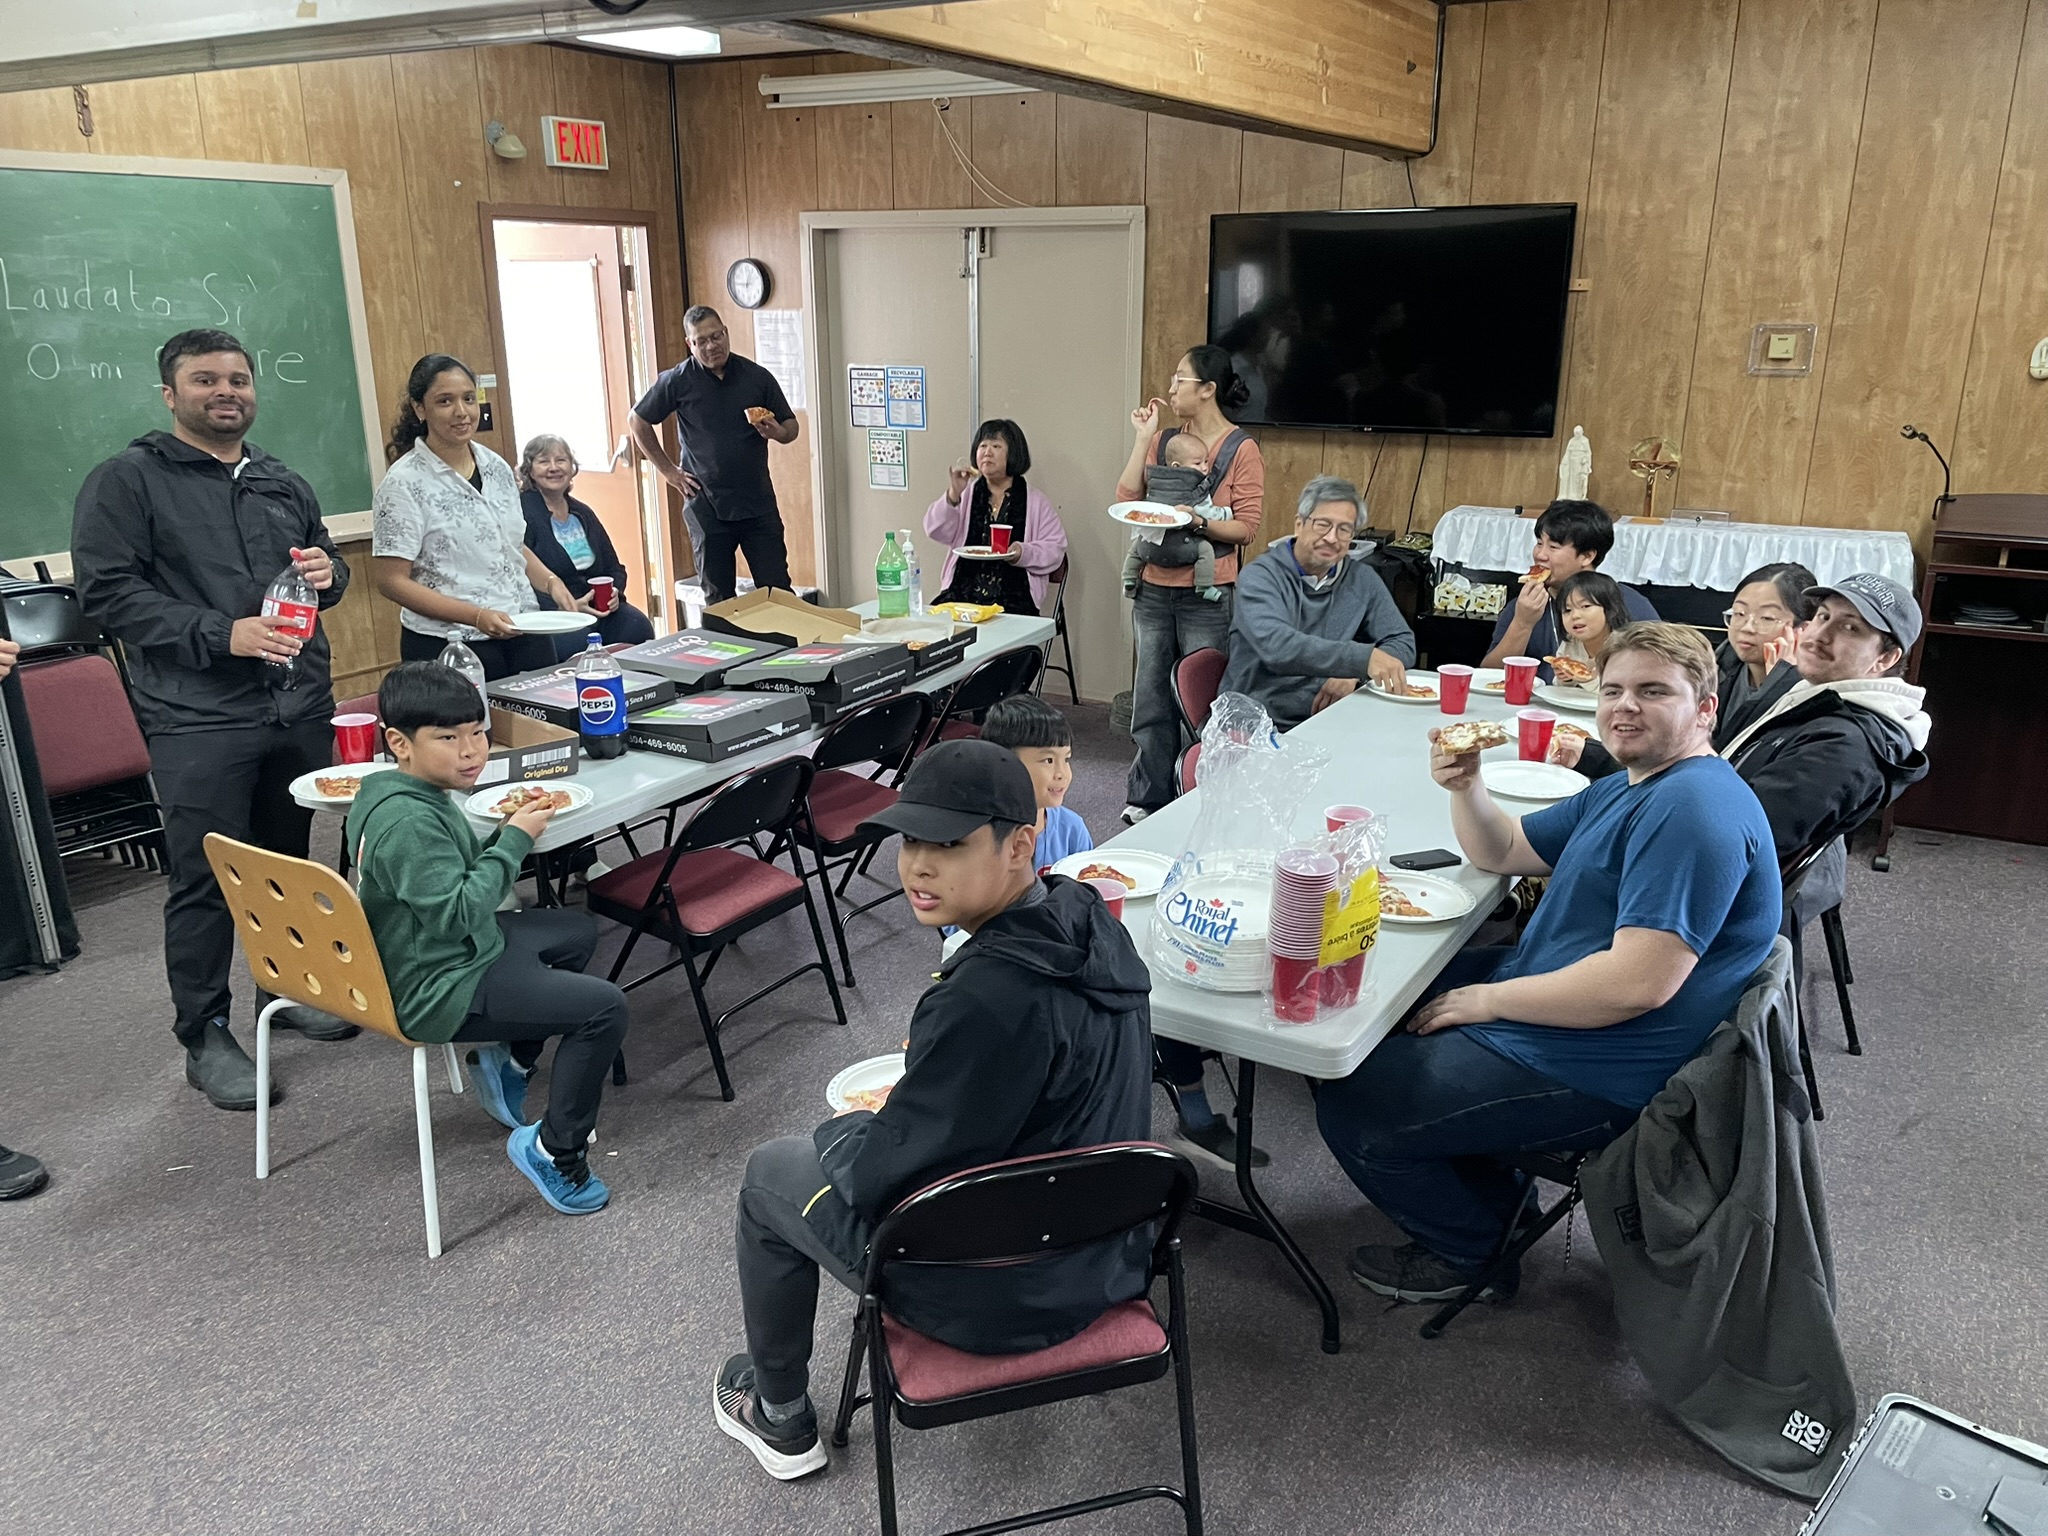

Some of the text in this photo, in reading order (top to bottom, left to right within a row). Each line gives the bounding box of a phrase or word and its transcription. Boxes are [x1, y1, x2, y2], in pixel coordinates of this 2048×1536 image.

[557, 121, 602, 165] EXIT
[0, 257, 171, 317] Laudato
[581, 700, 613, 709] PEPSI
[630, 696, 643, 705] Since
[524, 765, 568, 779] Original Dry
[1166, 891, 1238, 946] Chinet
[1195, 898, 1231, 921] Royal
[1360, 930, 1377, 950] 50
